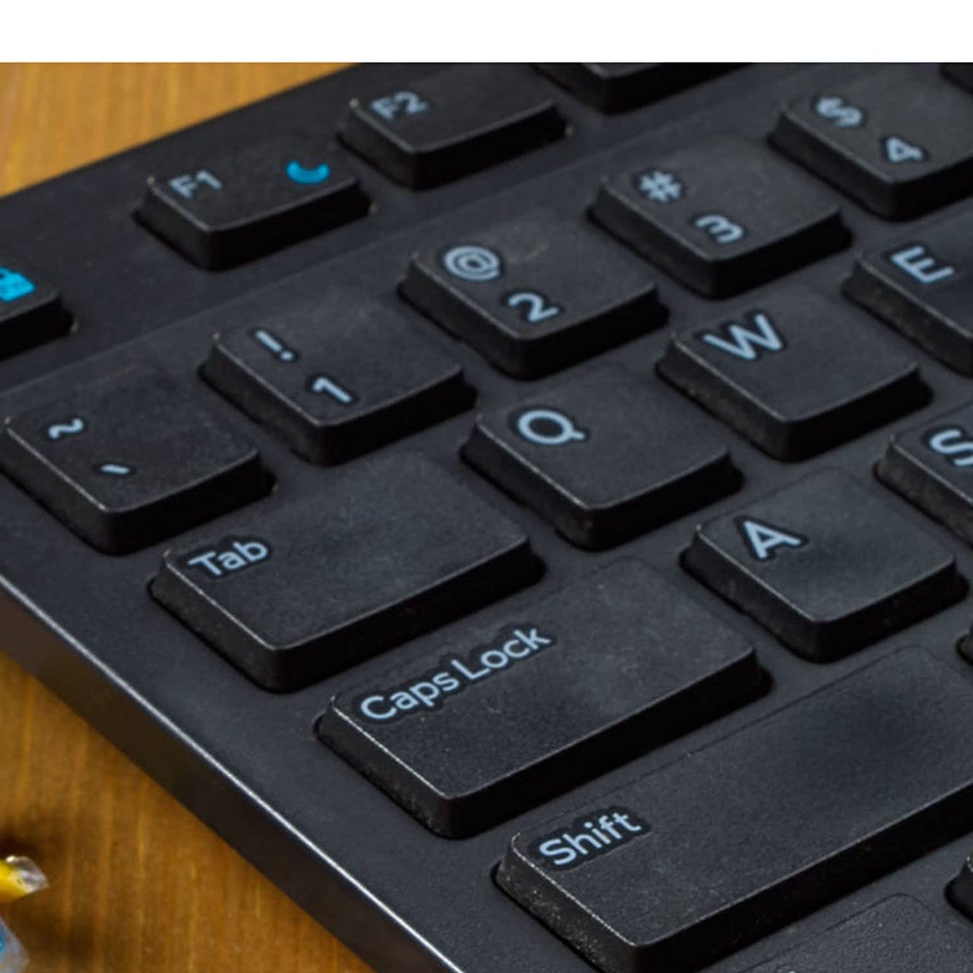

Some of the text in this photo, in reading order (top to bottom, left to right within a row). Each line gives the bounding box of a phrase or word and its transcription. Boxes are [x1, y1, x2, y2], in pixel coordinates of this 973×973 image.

[372, 92, 426, 119] F2
[817, 98, 862, 126] $
[887, 138, 922, 162] 4
[170, 170, 221, 198] F1
[641, 172, 680, 201] #
[697, 215, 743, 243] 3
[444, 246, 499, 280] @
[892, 246, 953, 283] E
[509, 293, 558, 322] 2
[256, 331, 293, 360] !
[704, 314, 782, 359] W
[313, 377, 351, 402] 1
[518, 410, 584, 445] Q
[930, 429, 973, 466] S
[744, 521, 800, 558] A
[188, 541, 268, 575] Tab
[360, 626, 551, 721] Caps Lock
[538, 811, 641, 866] Shift
